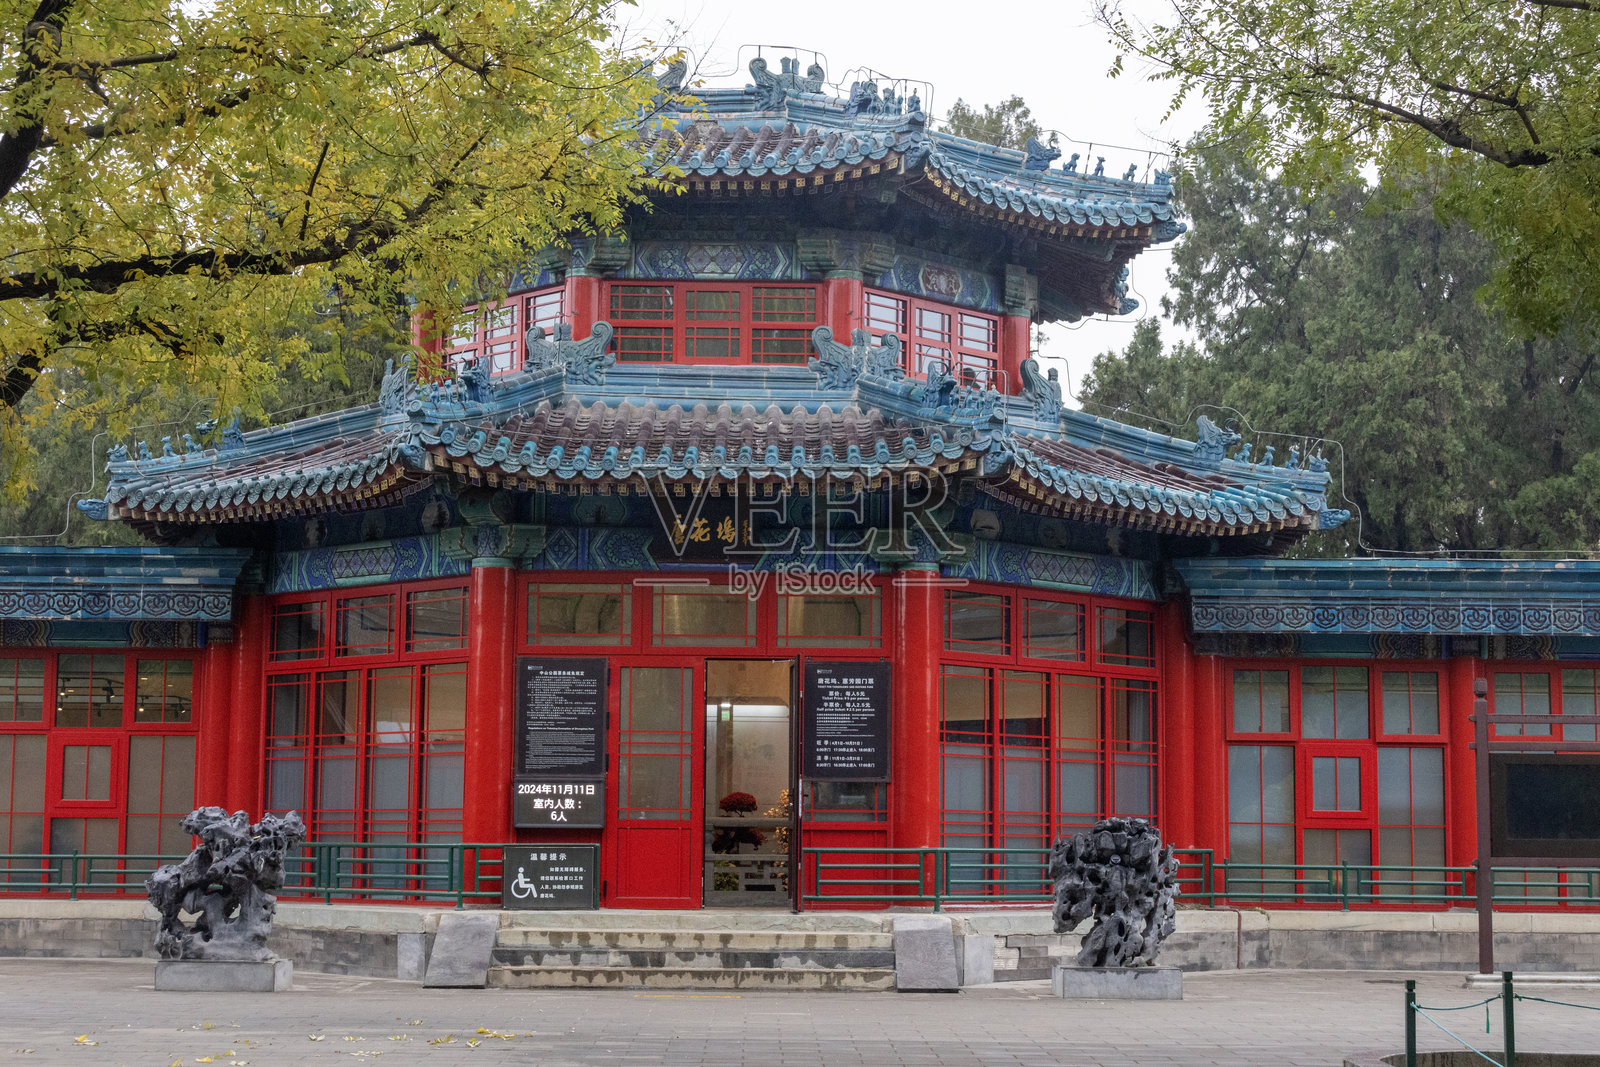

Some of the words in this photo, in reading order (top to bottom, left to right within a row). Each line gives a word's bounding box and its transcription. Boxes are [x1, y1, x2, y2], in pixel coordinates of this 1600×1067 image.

[518, 784, 595, 795] 2024年11月11日
[533, 798, 582, 809] 室内人数：
[550, 811, 568, 822] 6人
[530, 852, 567, 861] 温馨提示
